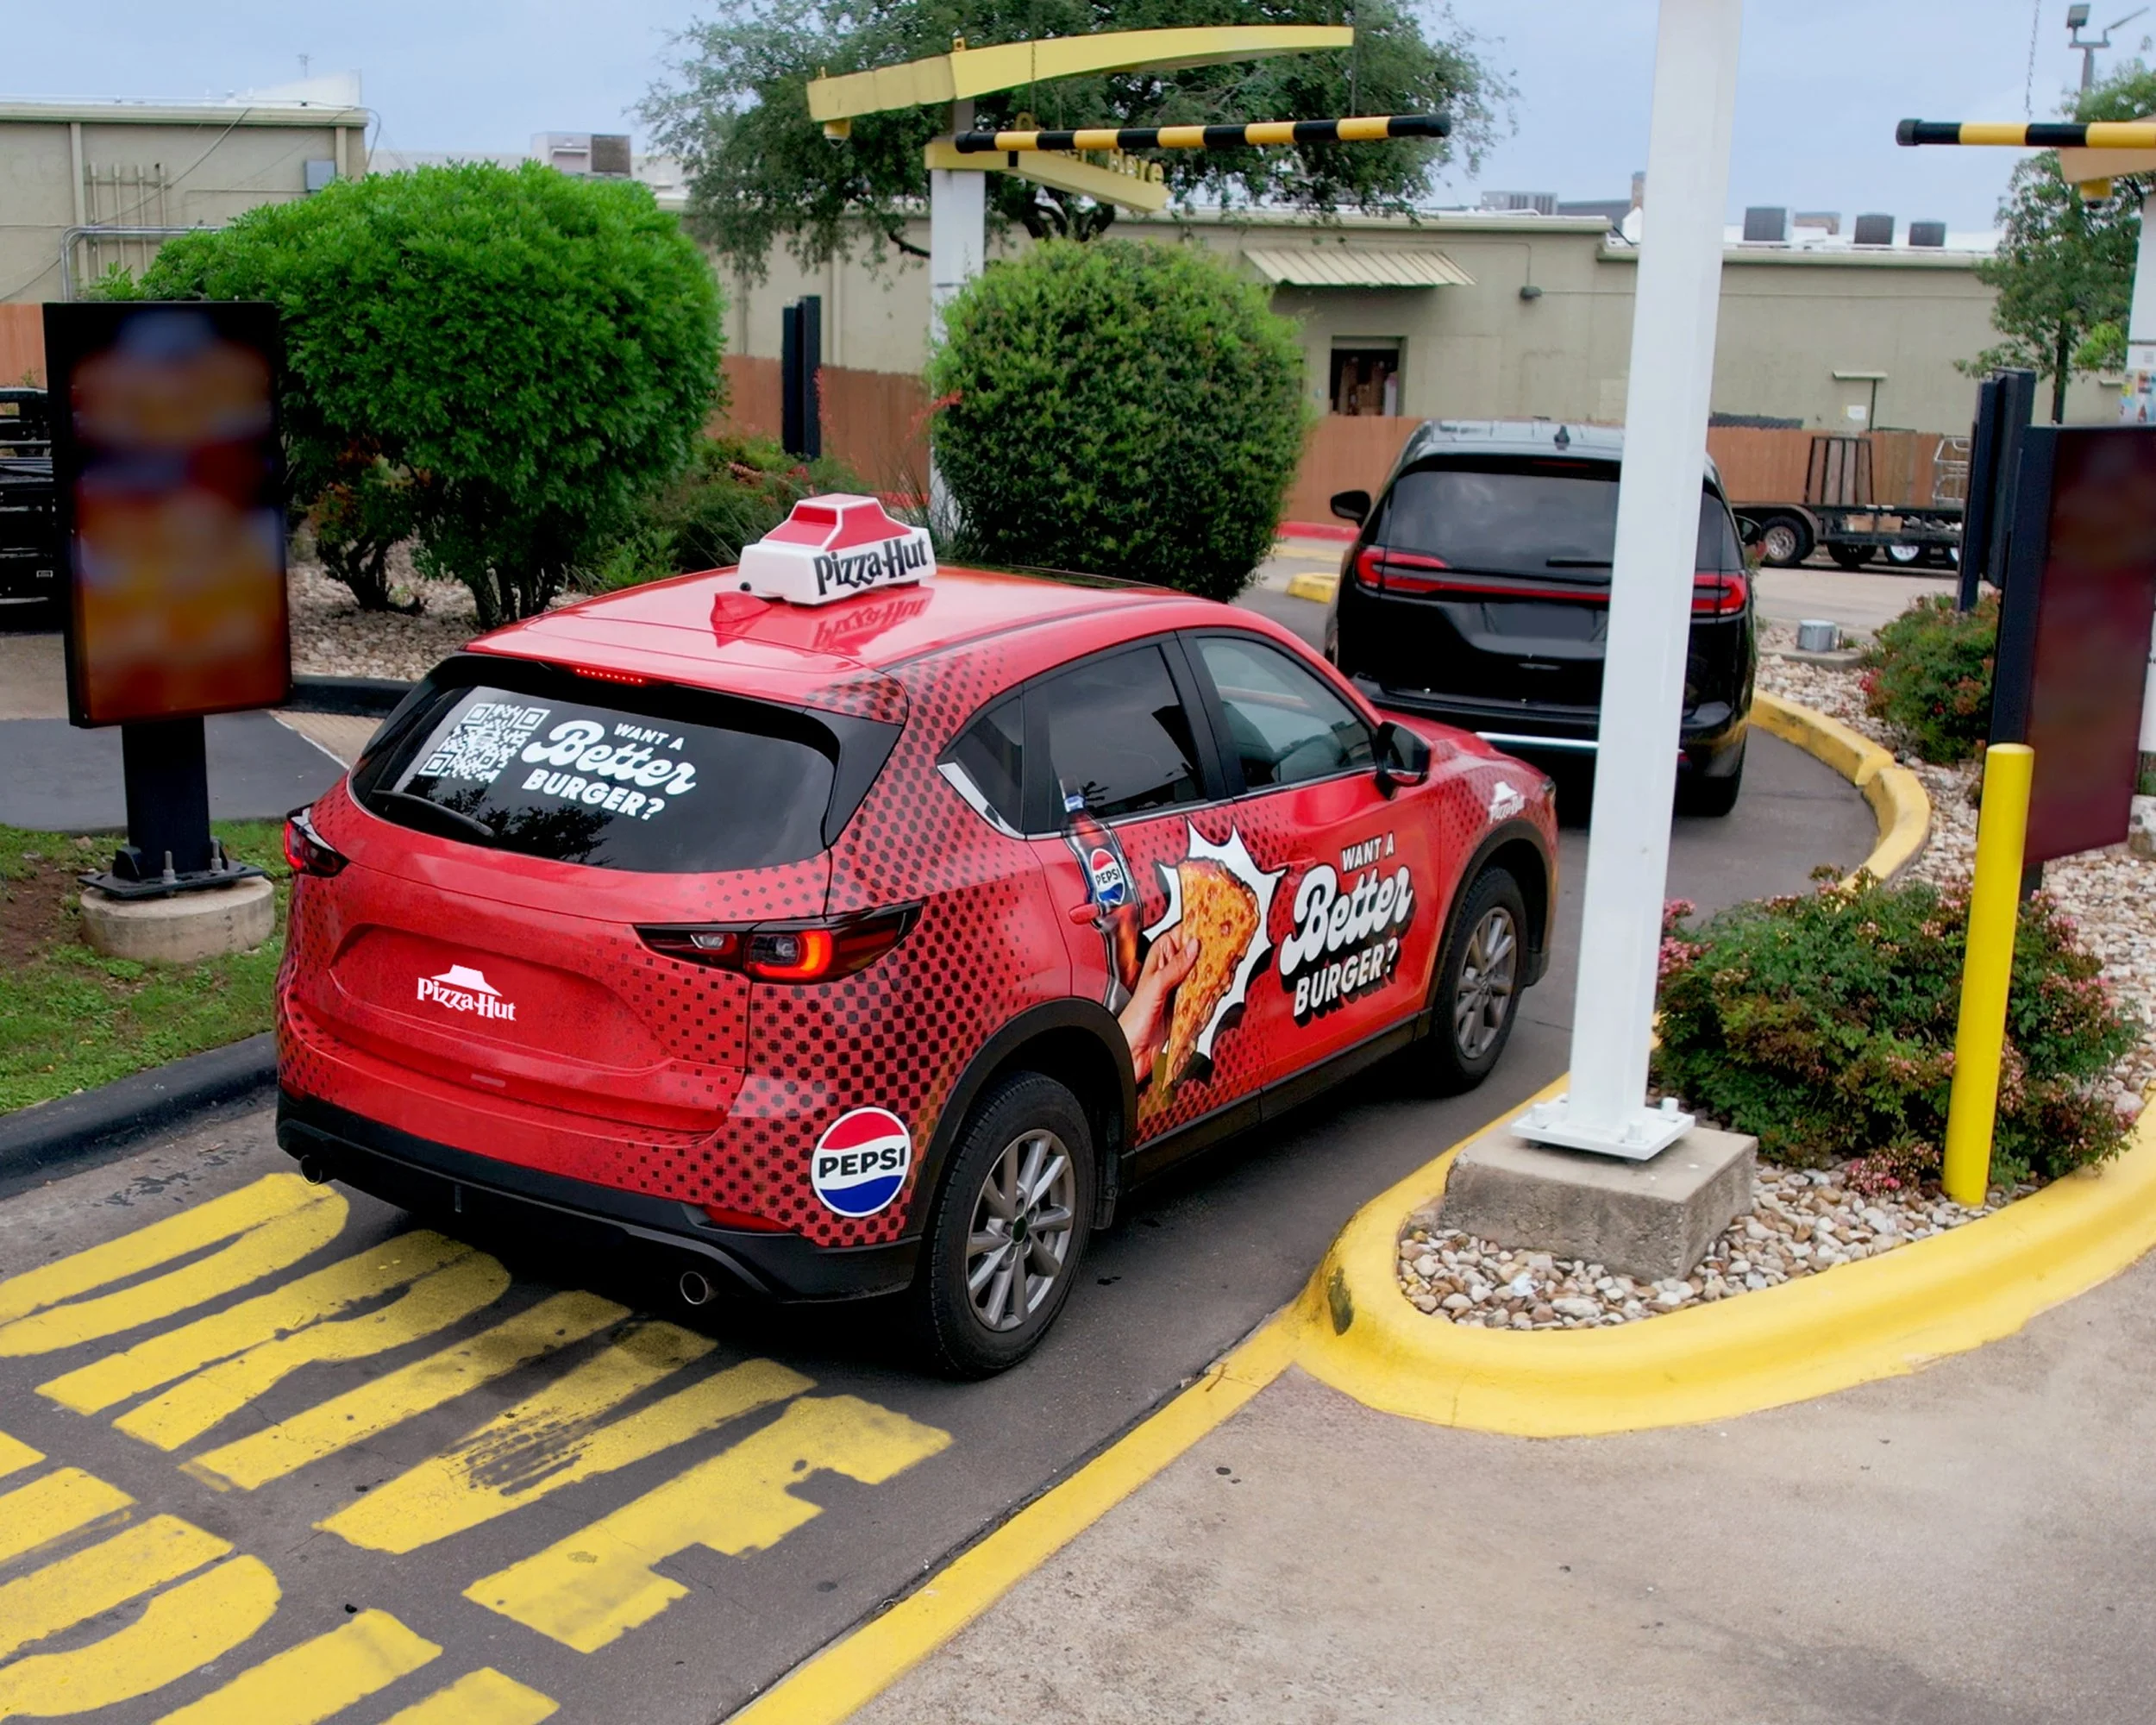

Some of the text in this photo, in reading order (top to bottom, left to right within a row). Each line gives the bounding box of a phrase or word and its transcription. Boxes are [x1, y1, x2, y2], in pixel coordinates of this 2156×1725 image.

[813, 536, 927, 596] Pizza Hut
[521, 720, 696, 794] Better
[614, 723, 684, 750] WANT A
[521, 768, 665, 820] BURGER?
[1342, 832, 1395, 872] WANT A
[1095, 869, 1121, 886] PEPSI
[1279, 864, 1413, 975] Better
[417, 977, 517, 1021] Pizza Hut
[1294, 937, 1398, 1017] BURGER?
[819, 1145, 906, 1178] PEPSI
